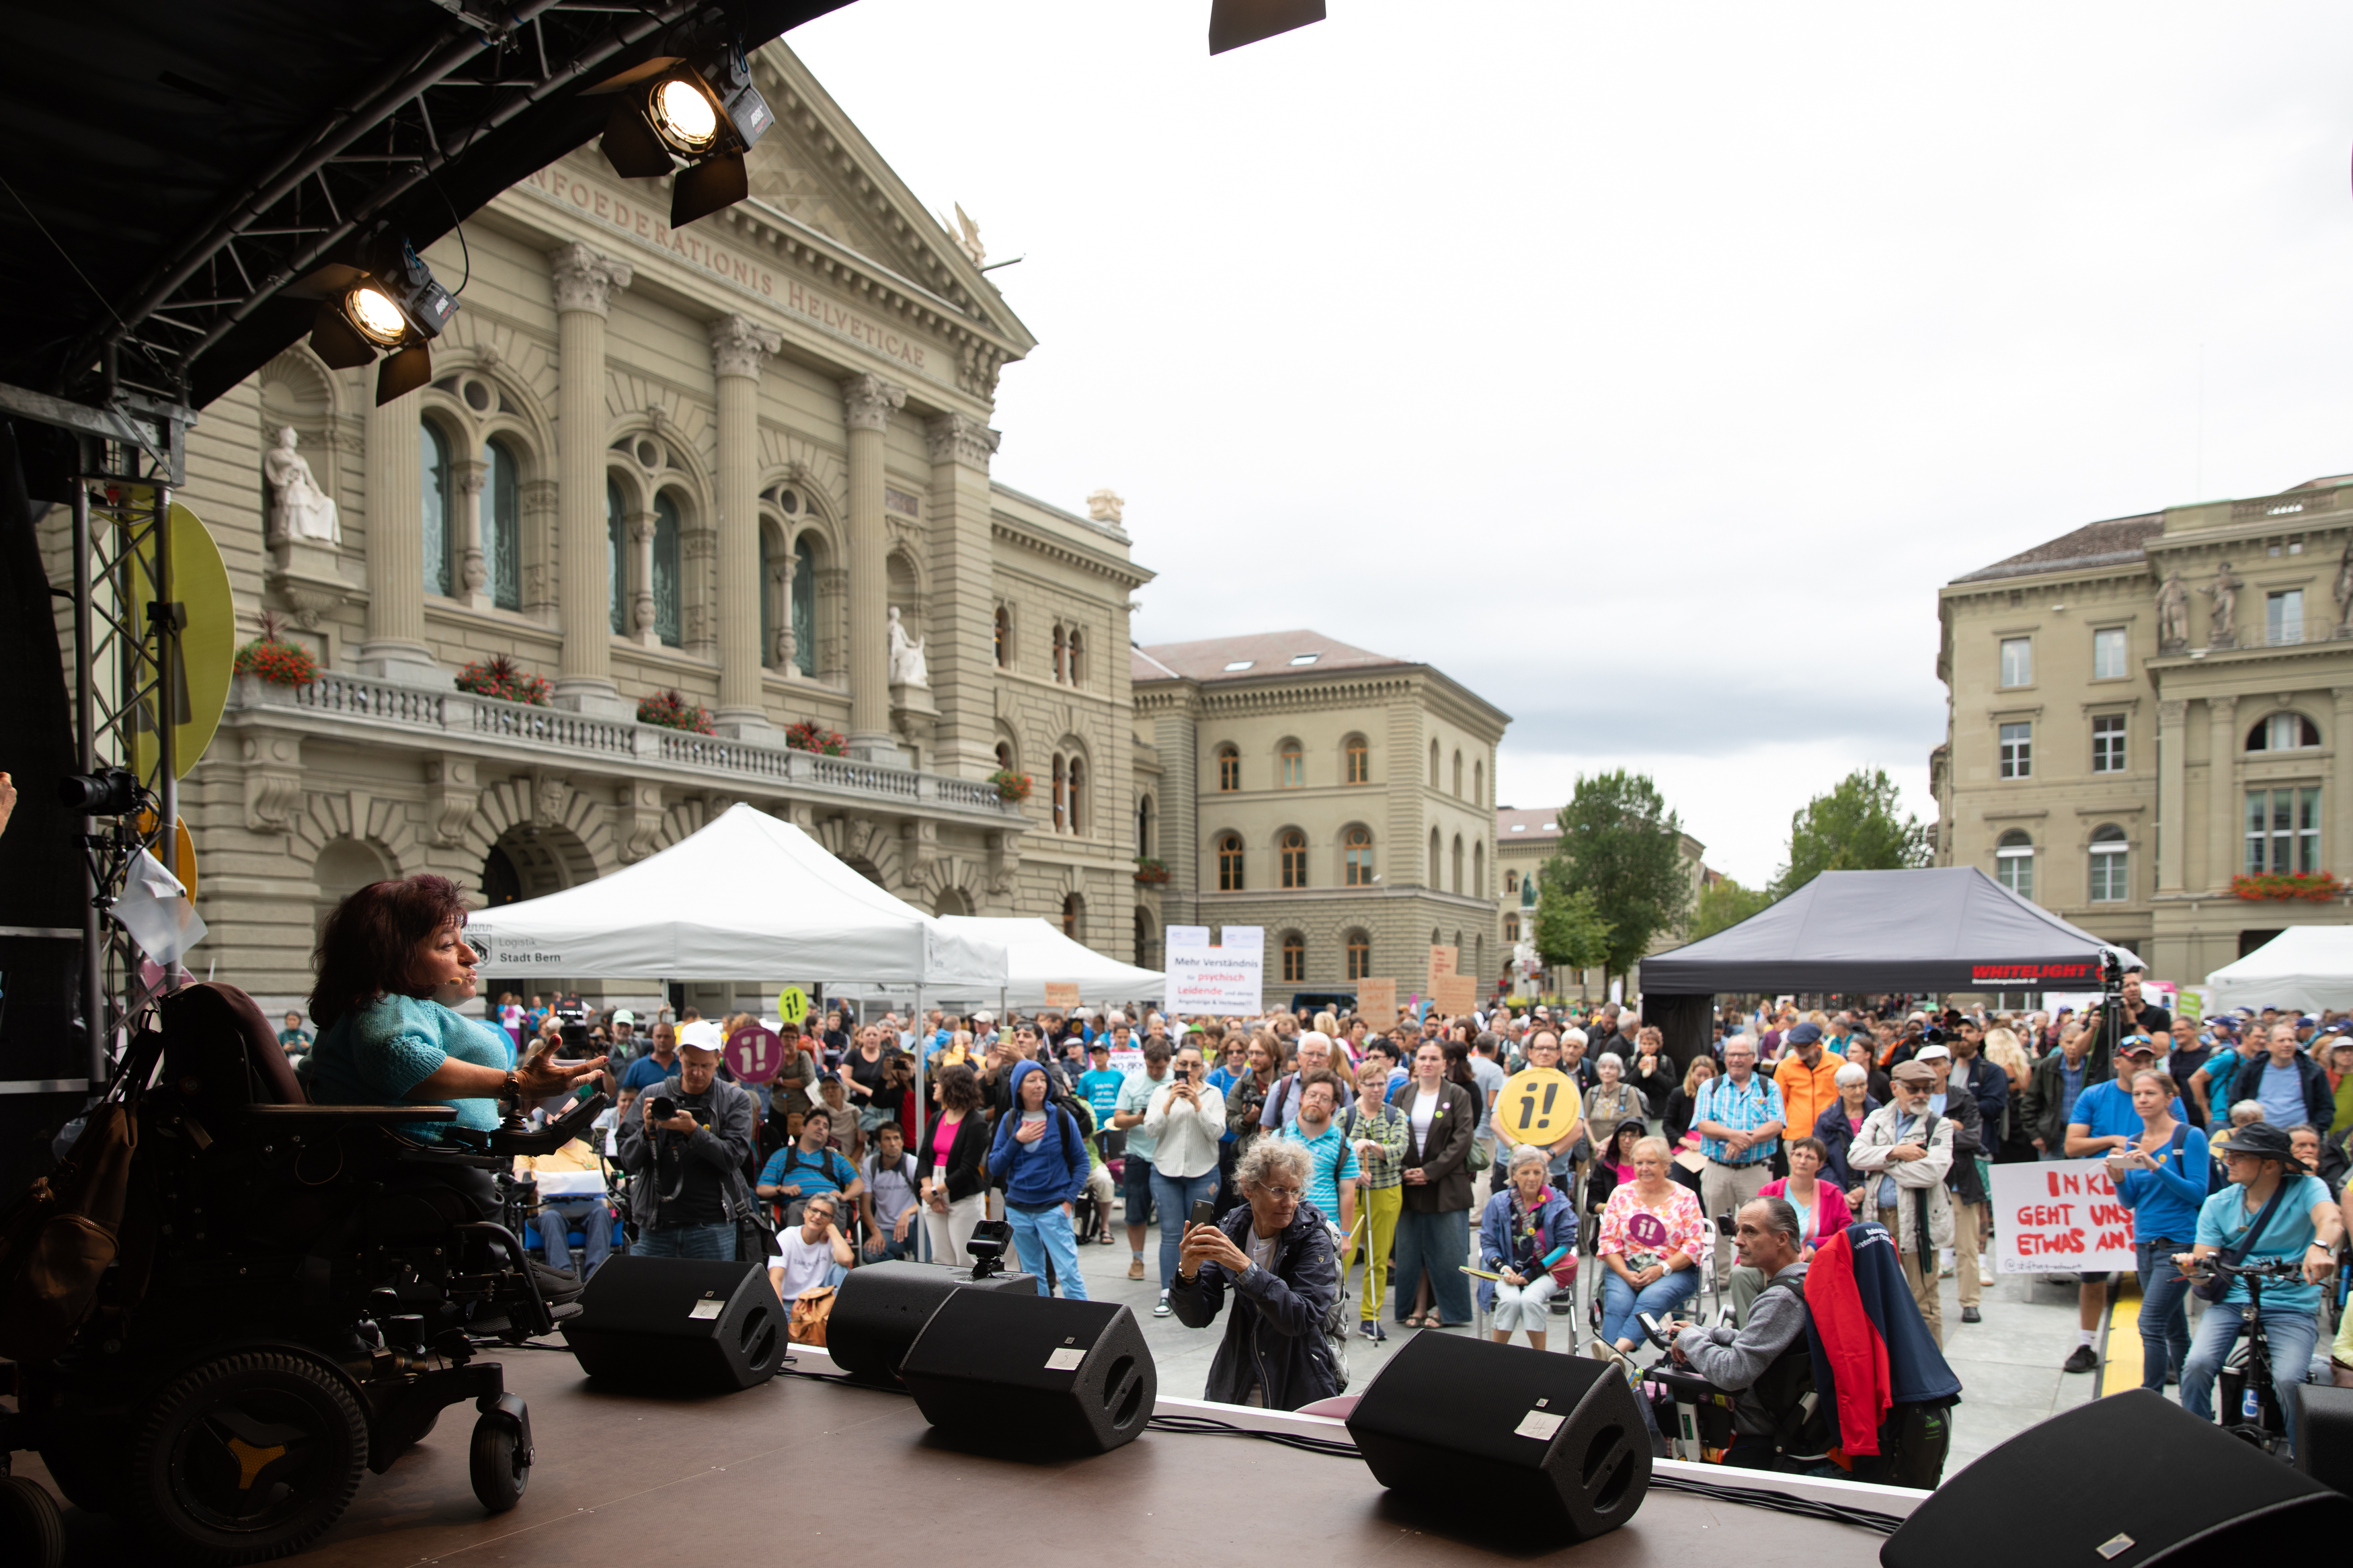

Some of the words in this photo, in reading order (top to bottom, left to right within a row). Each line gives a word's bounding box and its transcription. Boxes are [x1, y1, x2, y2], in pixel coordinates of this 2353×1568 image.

[789, 280, 926, 369] HELVETICAE
[499, 937, 537, 949] Logistik
[500, 952, 531, 962] Stadt
[534, 952, 561, 962] Bern
[1174, 957, 1200, 966] Mehr
[1203, 958, 1259, 968] Verständnis
[1972, 964, 2086, 978] WHITELIGHT
[1197, 972, 1245, 983] psychisch
[1177, 986, 1223, 995] Leidende
[2017, 1204, 2076, 1227] GEHT
[2089, 1203, 2134, 1227] UNS
[2017, 1227, 2085, 1256] ETWAS
[2095, 1224, 2137, 1253] AN!
[700, 1304, 710, 1316] 2
[1058, 1351, 1072, 1364] 3
[1532, 1417, 1546, 1435] 4
